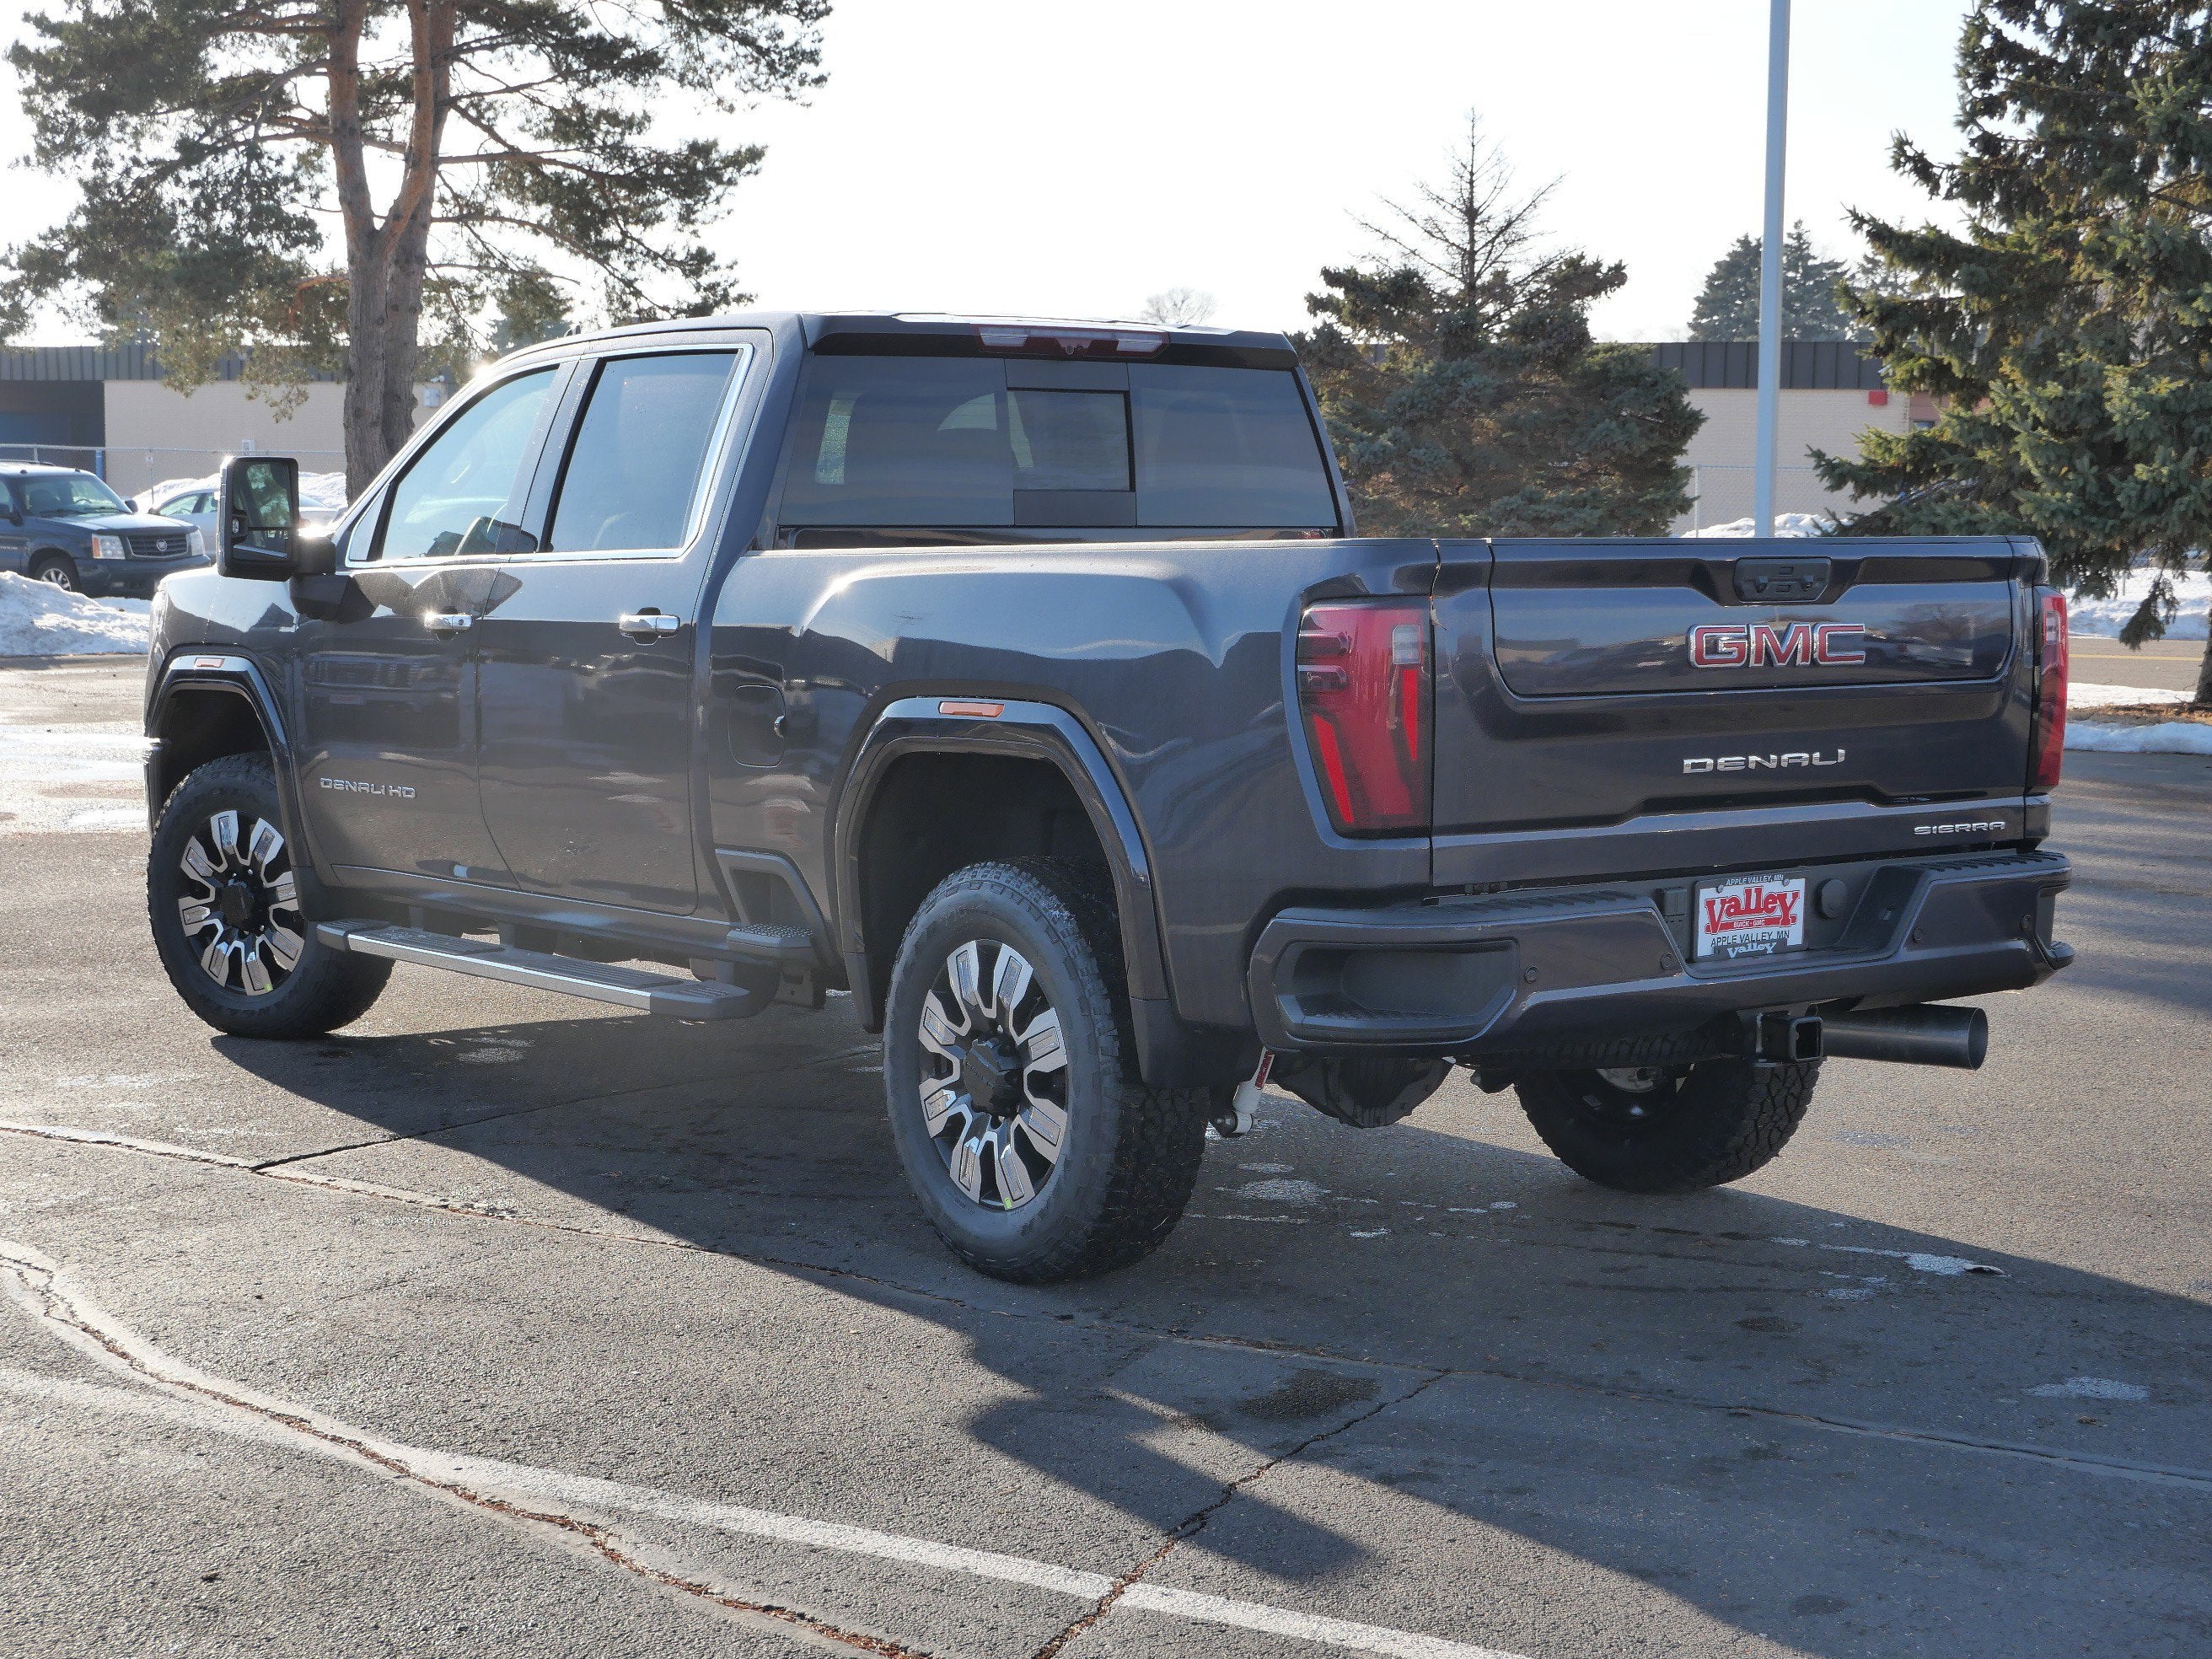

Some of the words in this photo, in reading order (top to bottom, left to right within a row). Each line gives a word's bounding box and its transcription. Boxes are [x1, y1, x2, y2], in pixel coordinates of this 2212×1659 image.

[1688, 623, 1866, 668] GMC
[1683, 749, 1845, 774] DENALI
[320, 777, 386, 796] DENALI
[389, 785, 416, 799] HD
[1914, 821, 2005, 835] SIERRA
[1726, 878, 1747, 886] APPLE
[1733, 920, 1749, 928] BUICK
[1710, 934, 1737, 948] APPLE
[1776, 930, 1790, 940] MN
